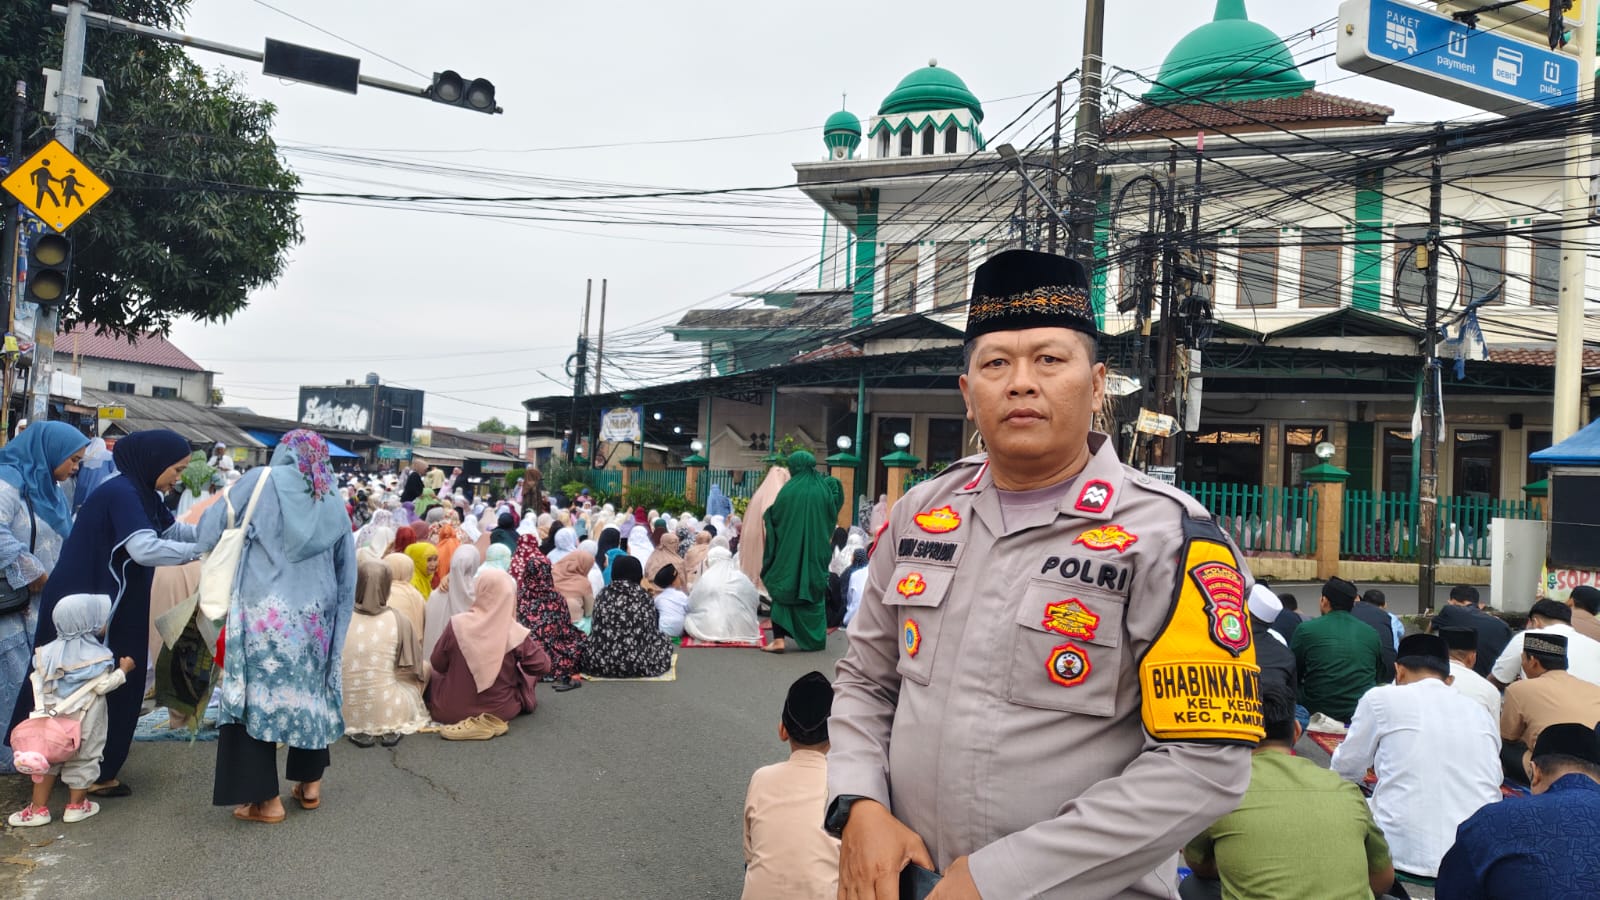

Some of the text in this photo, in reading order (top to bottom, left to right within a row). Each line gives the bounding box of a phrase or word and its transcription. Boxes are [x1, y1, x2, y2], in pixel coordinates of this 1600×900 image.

[1386, 10, 1420, 29] PAKET
[1437, 55, 1476, 74] payment
[1496, 69, 1517, 80] DEBIT
[1540, 84, 1562, 97] pulsa
[1041, 556, 1128, 591] POLRI
[1557, 569, 1590, 591] SOP
[1174, 711, 1216, 723] KEC.
